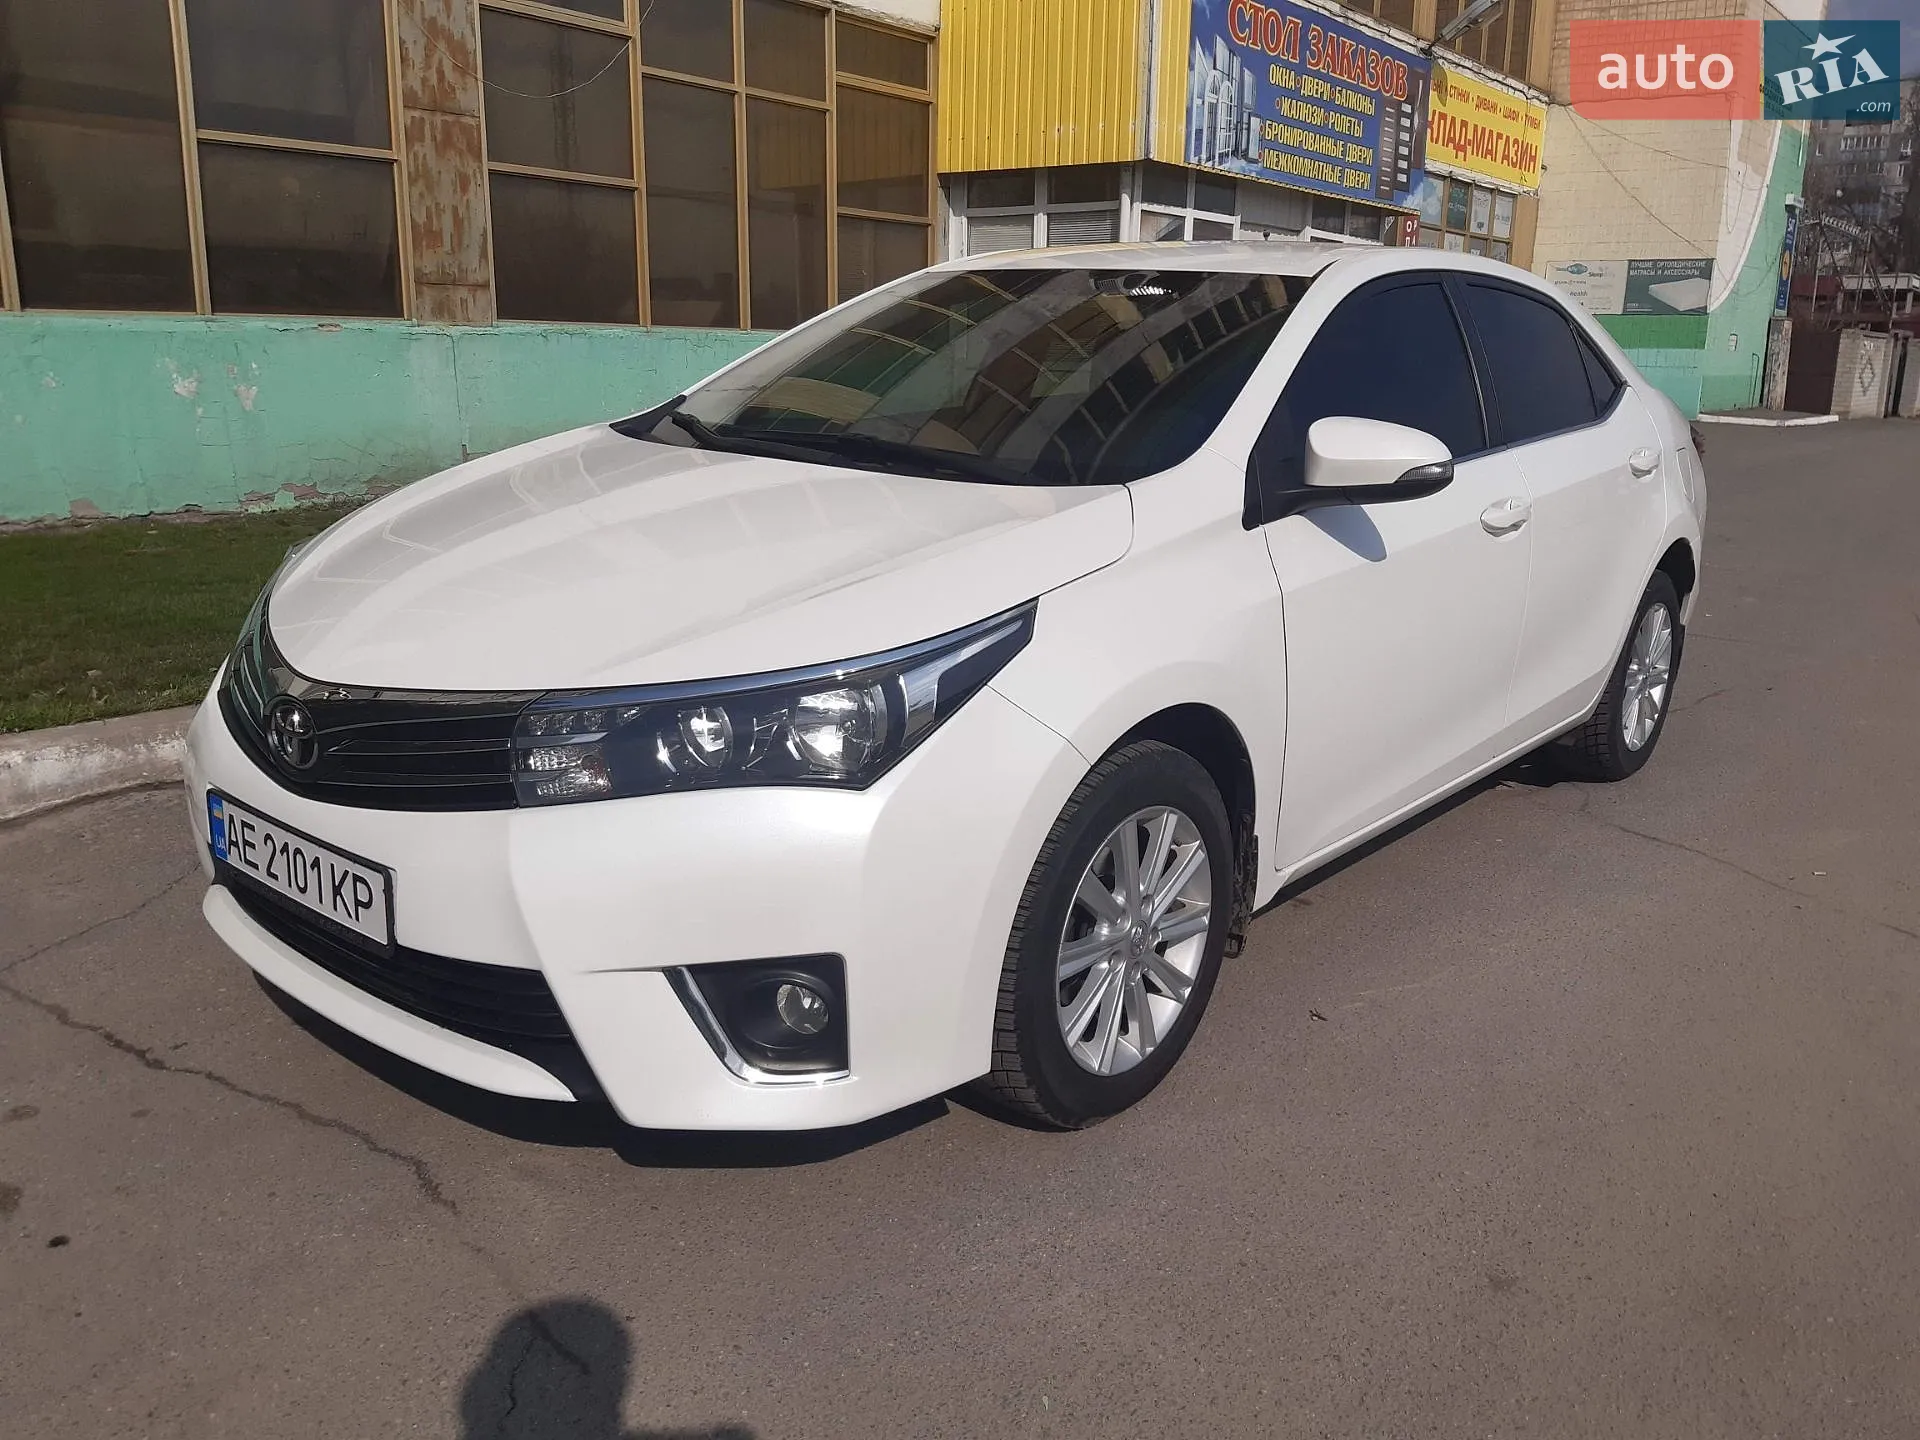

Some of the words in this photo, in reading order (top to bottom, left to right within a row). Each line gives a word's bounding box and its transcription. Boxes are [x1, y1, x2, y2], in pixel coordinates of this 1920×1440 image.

[1228, 0, 1302, 63] СТОЛ
[1306, 24, 1408, 100] ЗАКАЗОВ
[1269, 63, 1295, 91] ОКНА
[1300, 74, 1331, 102] ДВЕРИ
[1335, 86, 1376, 116] БАЛКОНЫ
[1280, 96, 1324, 127] ЖАЛЮЗИ
[1328, 111, 1363, 138] РОЛЕТЫ
[1265, 119, 1345, 159] БРОНИРОВАННЫЕ
[1345, 143, 1373, 167] ДВЕРИ
[1263, 148, 1342, 184] МЕЖКОМНАТНЫЕ
[1343, 168, 1371, 190] ДВЕРИ
[227, 813, 260, 871] AE
[263, 832, 324, 905] 2101
[330, 862, 374, 923] KP
